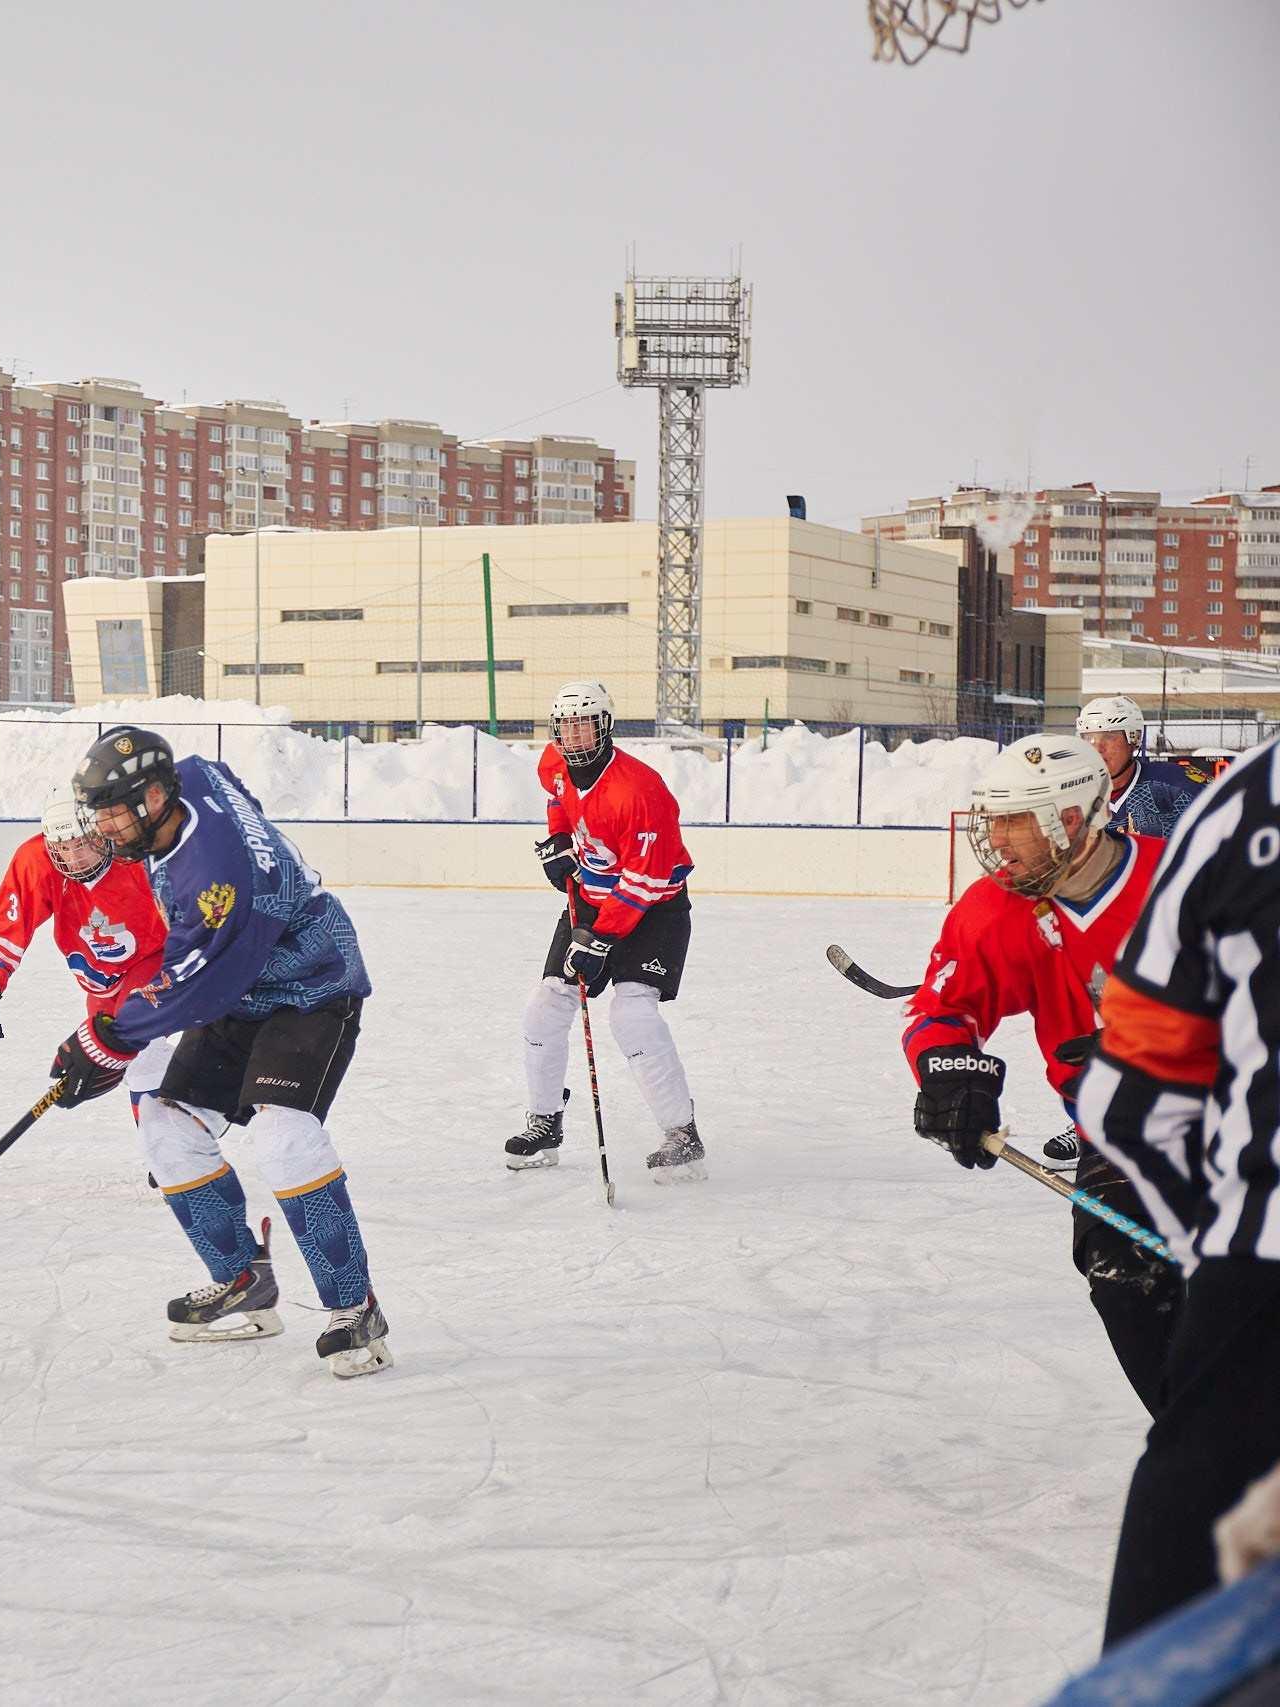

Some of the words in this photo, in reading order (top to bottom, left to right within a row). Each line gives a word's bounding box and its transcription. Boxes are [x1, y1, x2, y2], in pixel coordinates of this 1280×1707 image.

[1060, 774, 1094, 790] BAUER
[637, 832, 658, 857] 77
[6, 892, 19, 922] 3
[928, 1055, 1000, 1077] Reebok
[255, 1076, 301, 1089] BAUER
[31, 1075, 68, 1119] REKKE
